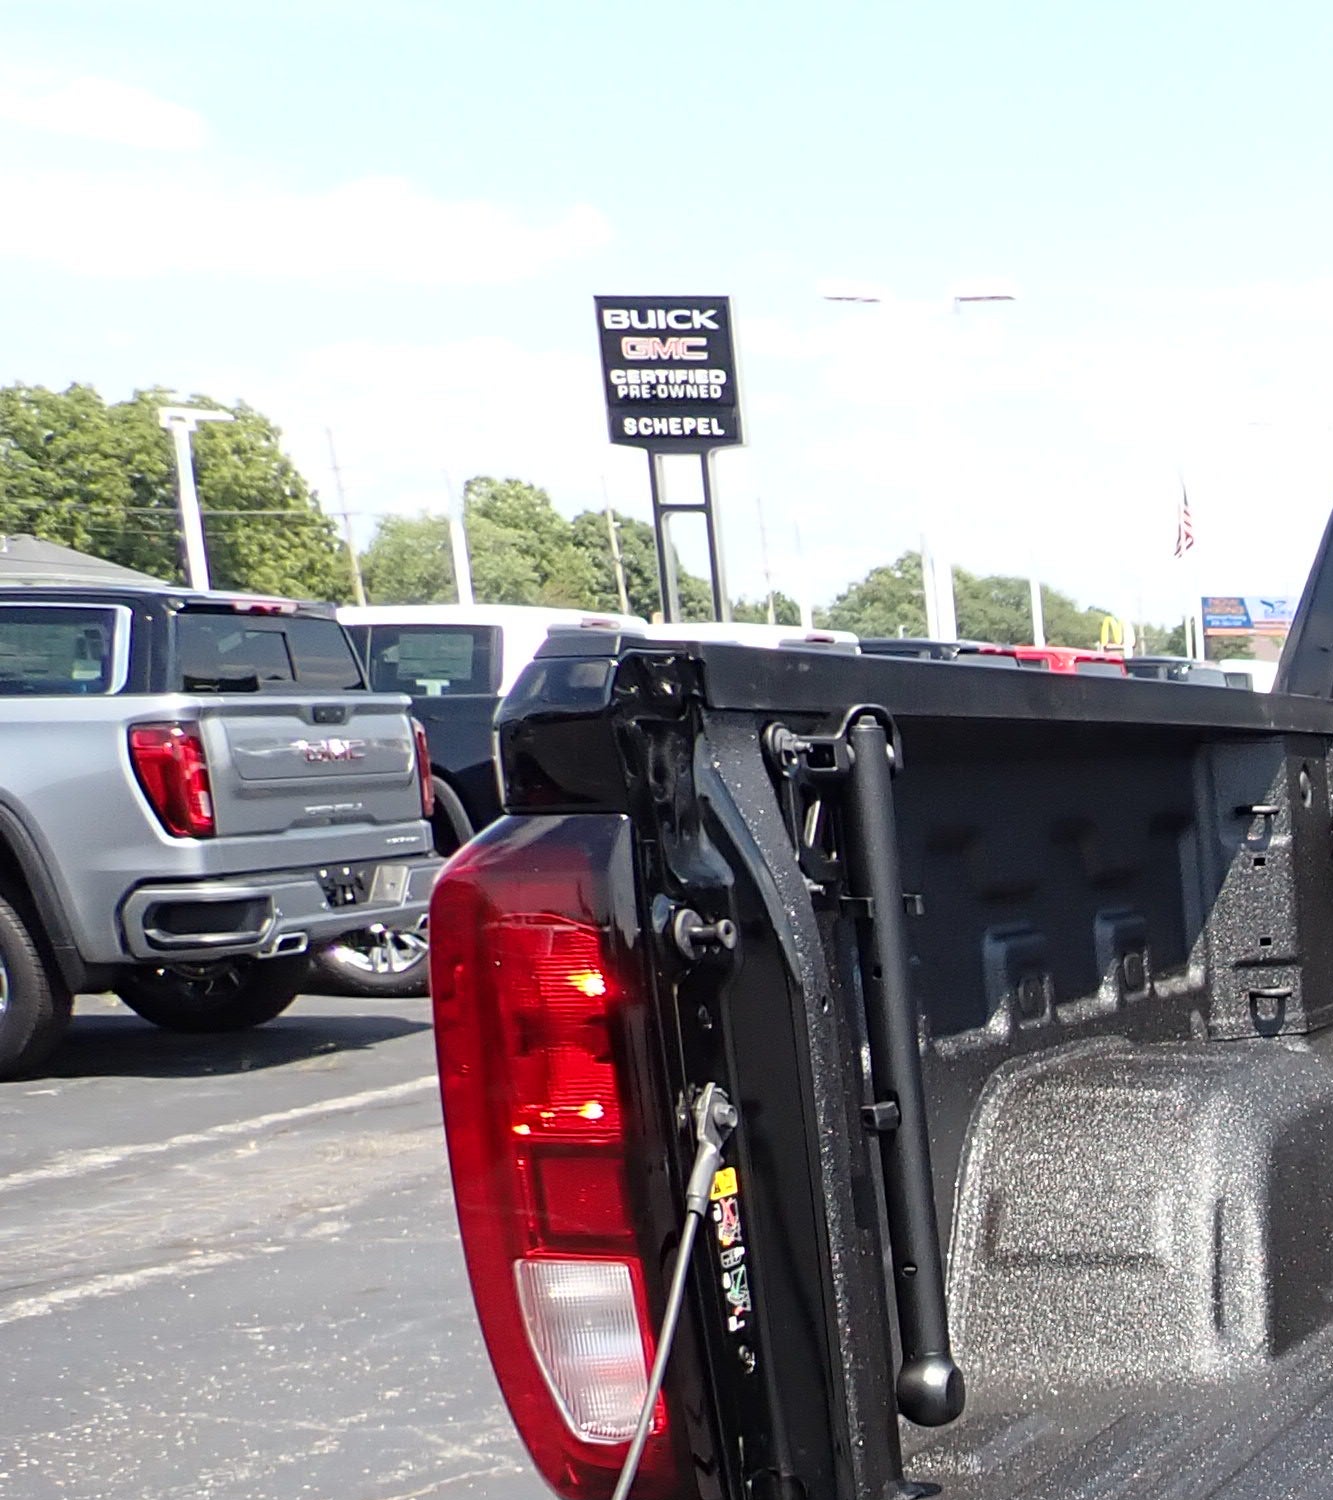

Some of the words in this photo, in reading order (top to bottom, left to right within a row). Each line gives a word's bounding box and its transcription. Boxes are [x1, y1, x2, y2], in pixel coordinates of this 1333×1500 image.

[602, 309, 719, 330] BUICK
[621, 337, 708, 360] GMC
[610, 369, 726, 385] CERTIFIED
[617, 384, 722, 399] PRE-OWNED
[623, 417, 725, 436] SCHEPEL
